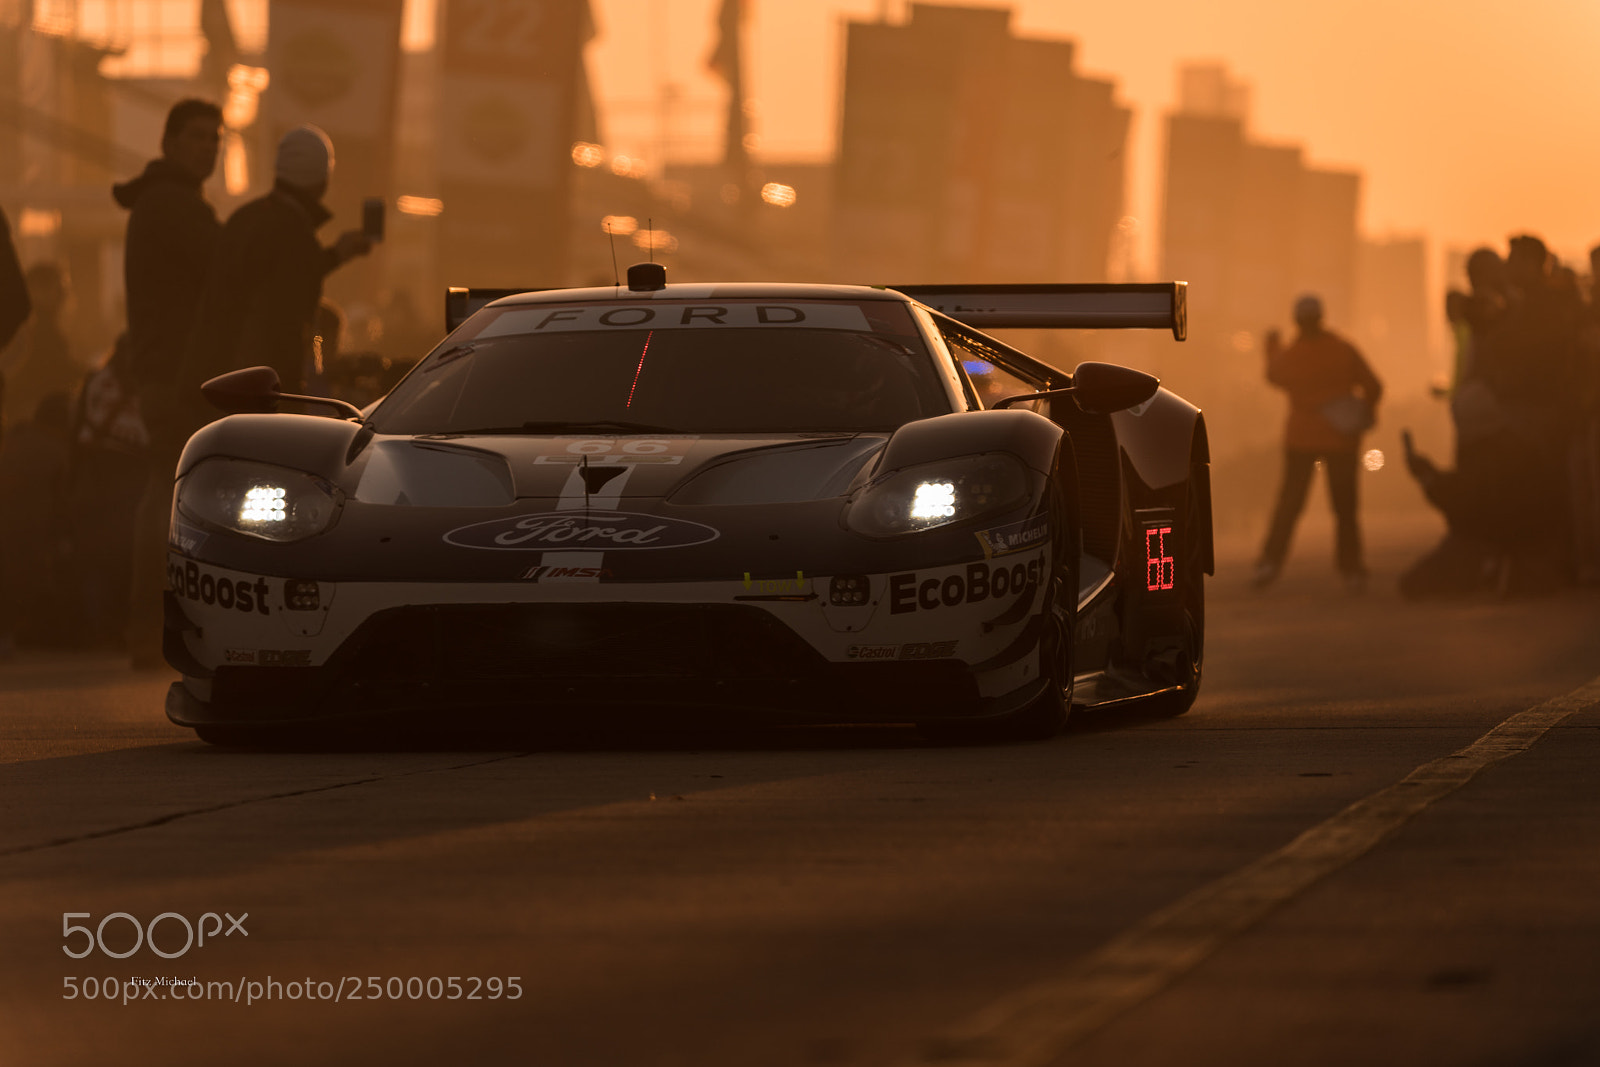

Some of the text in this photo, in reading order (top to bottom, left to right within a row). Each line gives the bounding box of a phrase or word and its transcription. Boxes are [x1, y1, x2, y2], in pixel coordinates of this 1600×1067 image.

[534, 306, 806, 331] FORD
[565, 439, 672, 455] 66
[494, 516, 668, 545] Ford
[1007, 523, 1048, 546] MICHELIN
[1146, 527, 1174, 591] 66
[757, 580, 792, 593] TOW
[889, 550, 1045, 615] EcoBoost
[858, 640, 960, 660] Castrol EDGE
